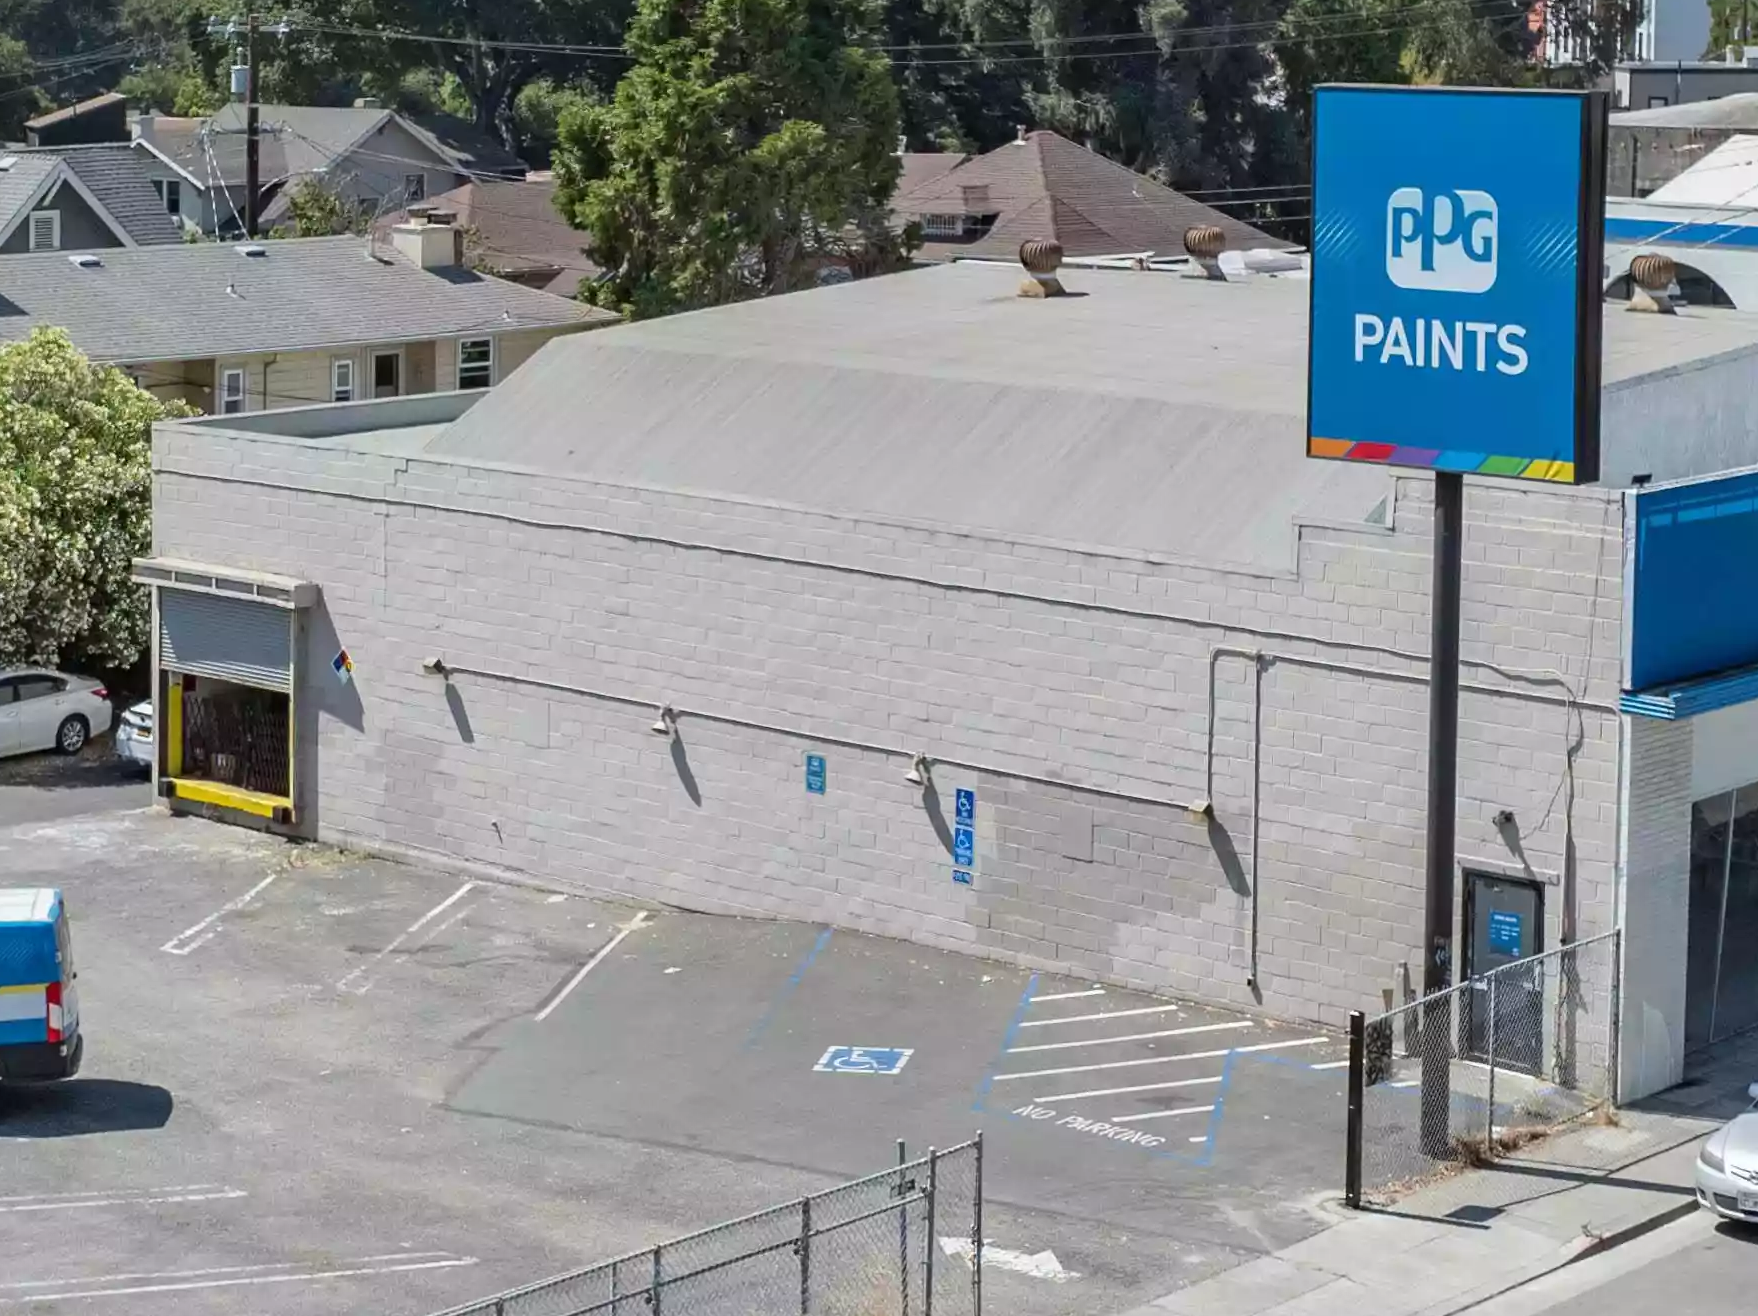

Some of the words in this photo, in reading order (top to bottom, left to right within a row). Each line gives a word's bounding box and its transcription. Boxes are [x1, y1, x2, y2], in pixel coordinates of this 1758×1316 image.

[1390, 188, 1495, 276] PPG
[1354, 312, 1529, 376] PAINTS
[1012, 1104, 1056, 1121] NO
[1055, 1115, 1166, 1149] PARKING
